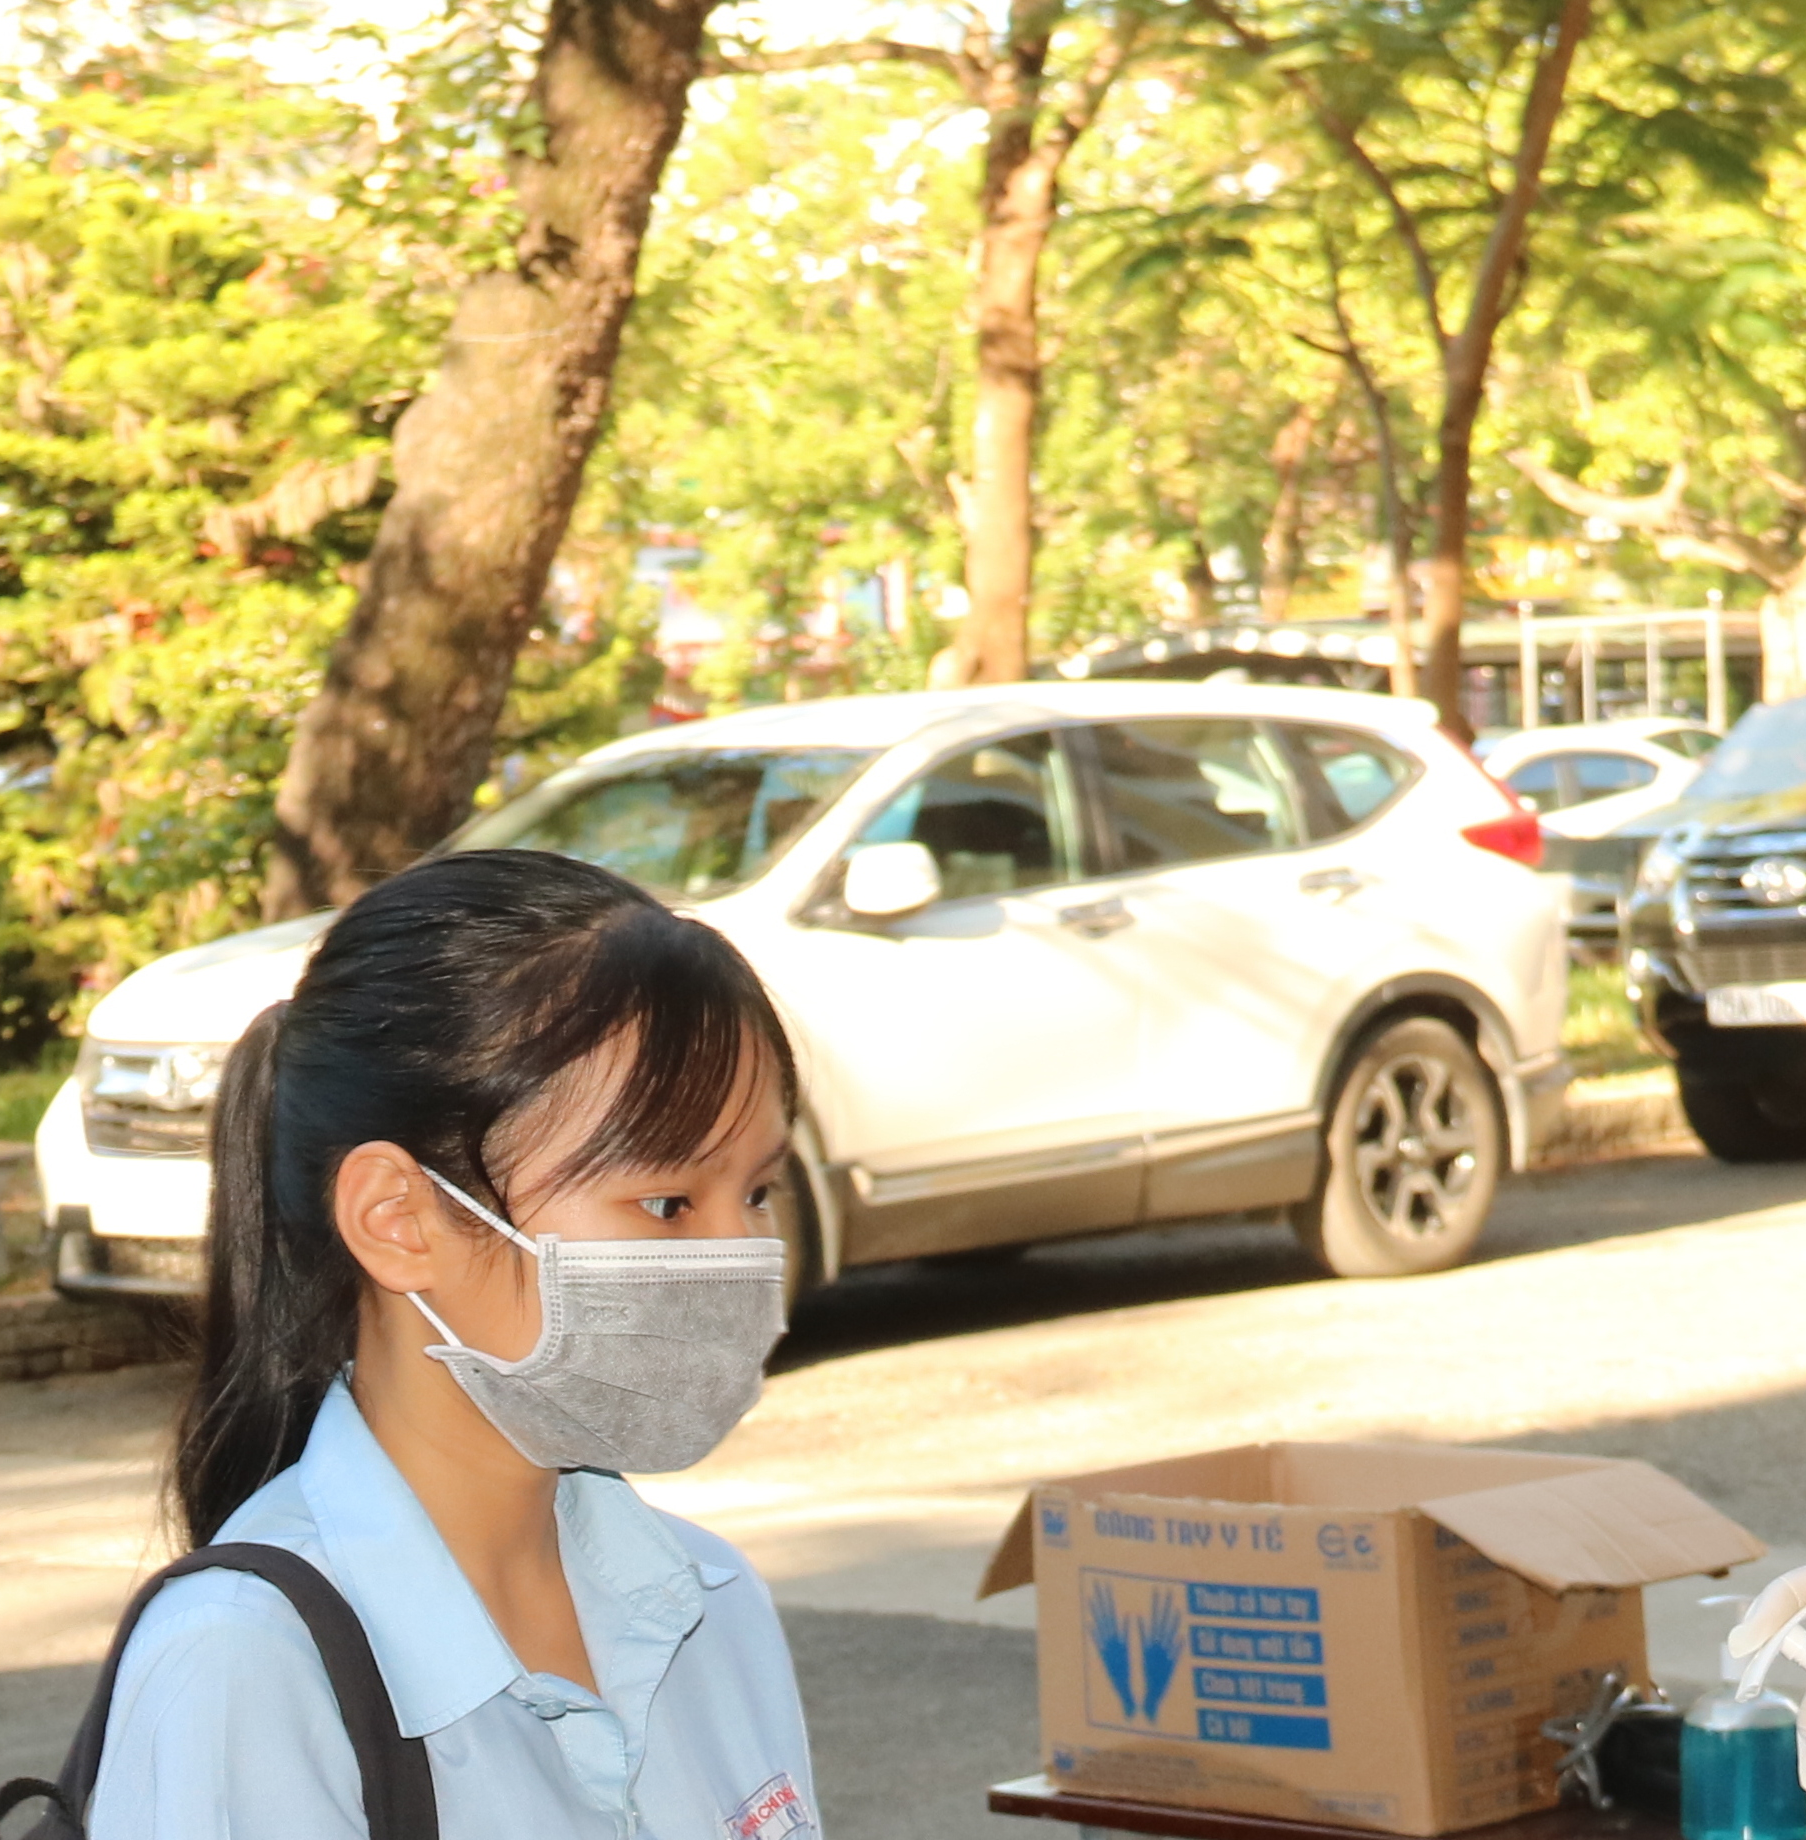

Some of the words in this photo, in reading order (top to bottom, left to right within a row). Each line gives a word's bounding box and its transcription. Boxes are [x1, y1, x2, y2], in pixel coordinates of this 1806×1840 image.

[1165, 1517, 1211, 1547] TAY
[1221, 1522, 1238, 1548] Y
[1250, 1514, 1283, 1552] TẾ
